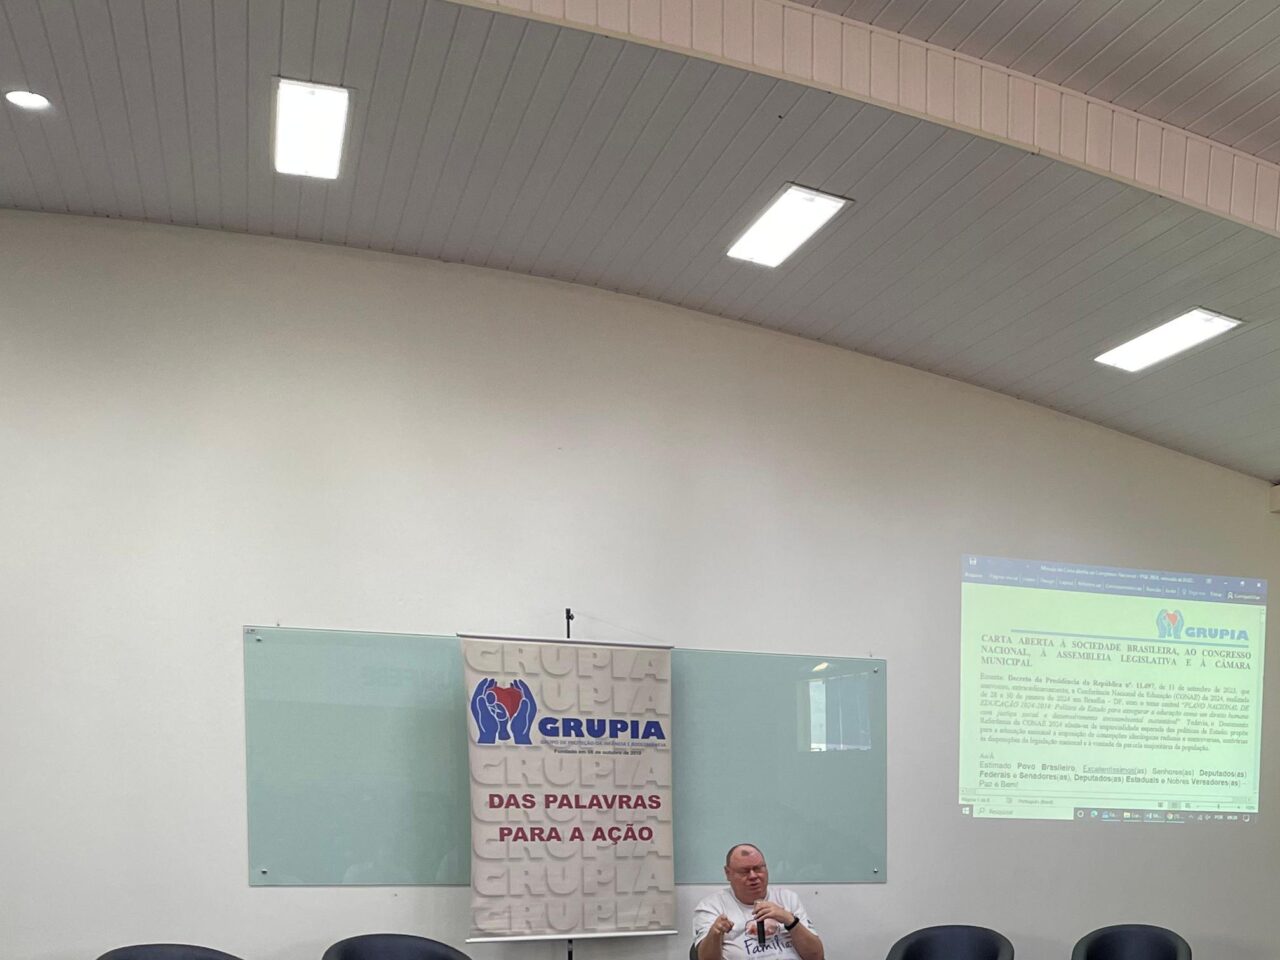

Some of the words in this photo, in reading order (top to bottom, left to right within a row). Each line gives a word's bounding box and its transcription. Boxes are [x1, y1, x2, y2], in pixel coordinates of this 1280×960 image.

[1185, 627, 1249, 641] GRUPIA
[981, 634, 1012, 644] CARTA
[1019, 638, 1054, 647] ABERTA
[1072, 641, 1121, 651] SOCIEDADE
[1127, 645, 1180, 656] BRASILEIRA,
[1202, 649, 1252, 660] CONGRESSO
[981, 646, 1031, 657] NACIONAL,
[1057, 650, 1112, 662] ASSEMBLEIA
[1121, 655, 1177, 666] LEGISLATIVA
[1186, 659, 1191, 667] E
[1215, 659, 1251, 670] CÂMARA
[981, 656, 1032, 667] MUNICIPAL
[538, 716, 666, 740] GRUPIA
[979, 761, 1012, 769] Estimado
[1017, 762, 1036, 770] Povo
[979, 770, 1011, 779] Federais
[1126, 776, 1159, 784] Estaduais
[488, 793, 536, 809] DAS
[544, 793, 662, 809] PALAVRAS
[499, 827, 562, 842] PARA
[569, 827, 585, 842] A
[591, 823, 654, 846] AÇÃO
